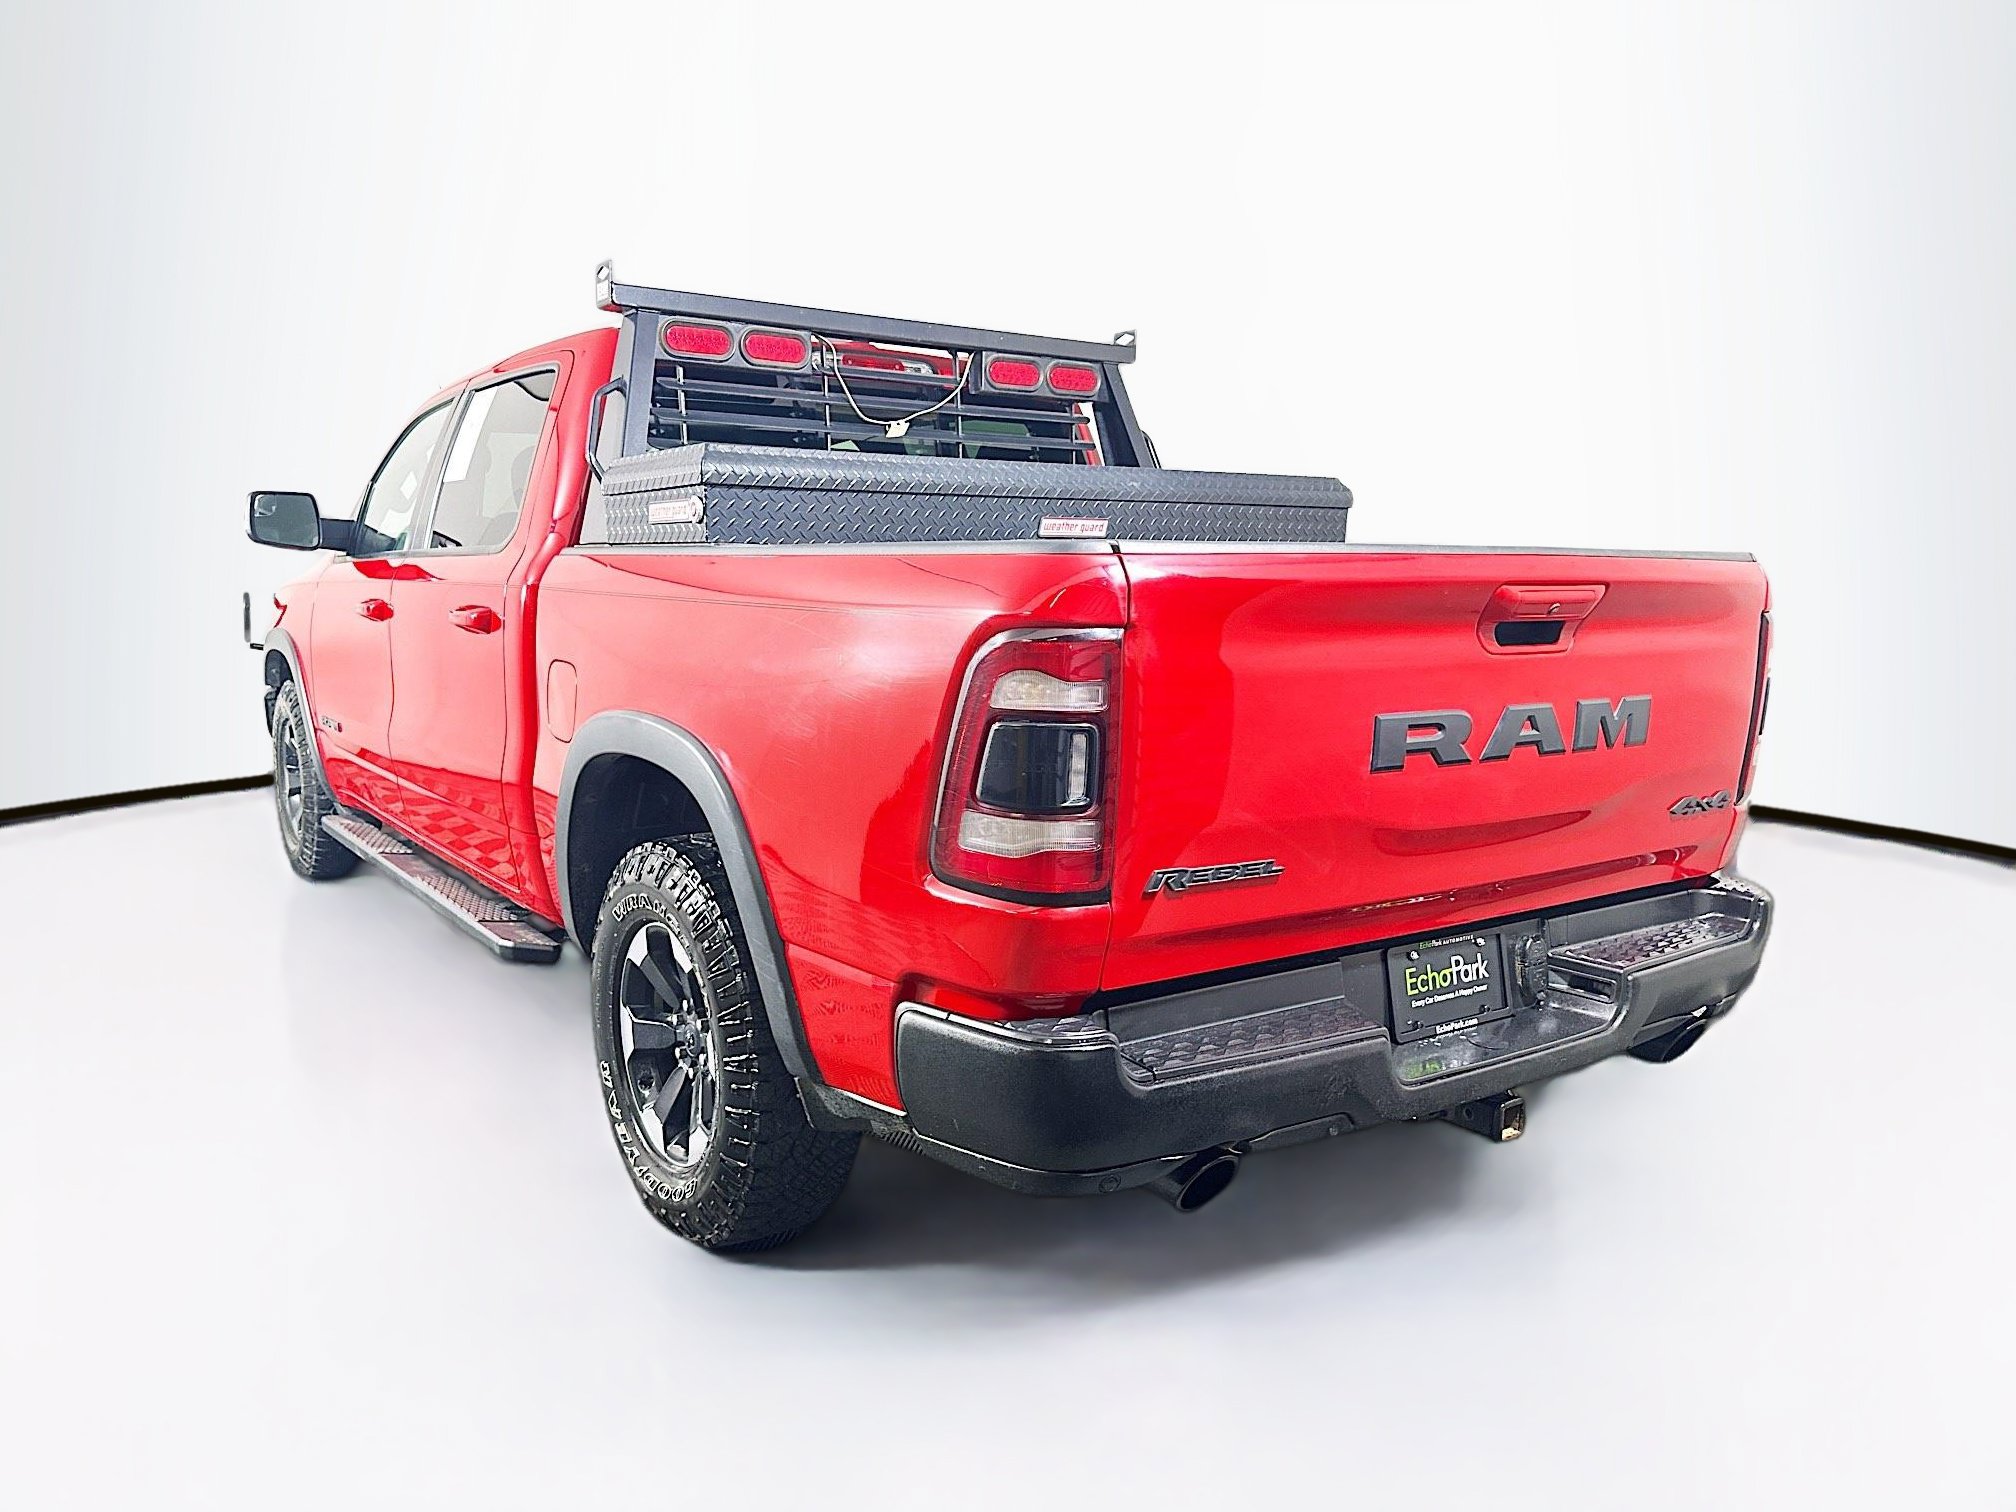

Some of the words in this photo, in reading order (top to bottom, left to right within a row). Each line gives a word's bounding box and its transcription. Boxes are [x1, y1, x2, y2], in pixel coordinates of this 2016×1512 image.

[1043, 521, 1079, 532] weather
[1080, 522, 1105, 533] guard
[1370, 695, 1652, 774] RAM
[1147, 859, 1285, 892] REBEL
[1419, 939, 1442, 950] EchoPark
[1442, 934, 1475, 945] AUTOMOTIVE
[1405, 952, 1490, 996] EchoPark
[1411, 999, 1426, 1008] Every
[1425, 996, 1435, 1005] Car
[1435, 1017, 1479, 1035] EchoPark.com
[600, 1061, 698, 1202] GOODYEAR
